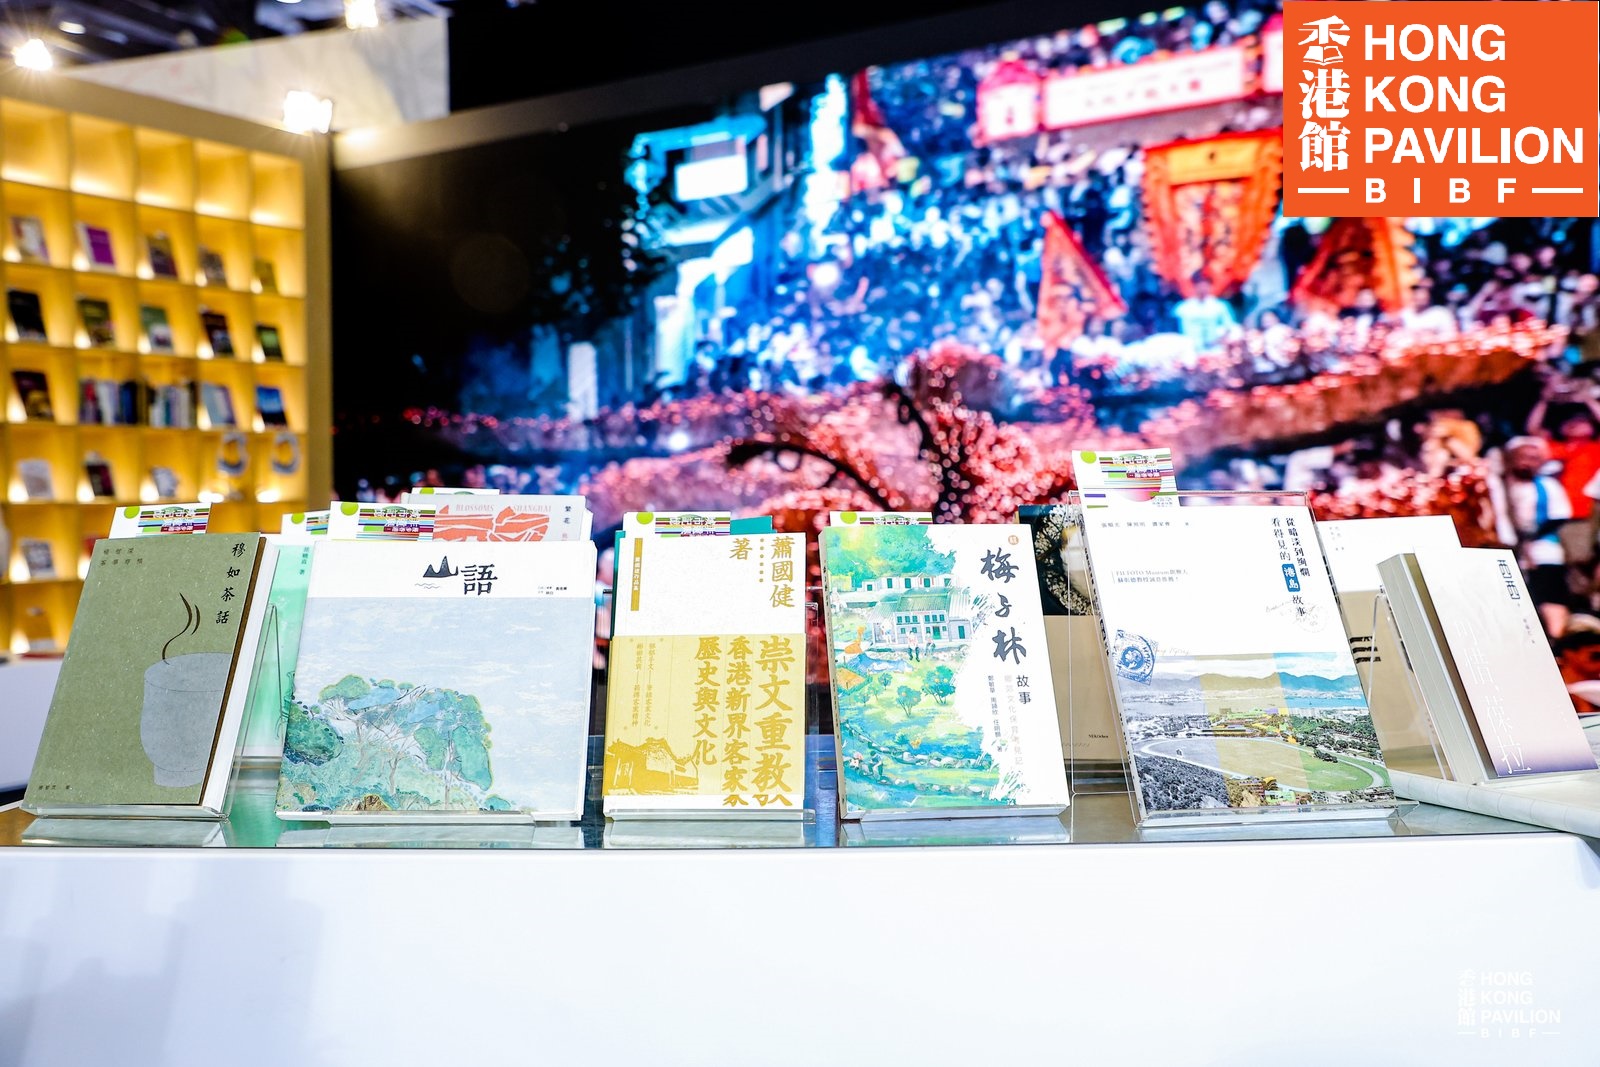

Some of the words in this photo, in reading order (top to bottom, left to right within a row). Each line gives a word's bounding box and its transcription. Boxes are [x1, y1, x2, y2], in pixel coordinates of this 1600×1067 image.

[455, 504, 495, 512] BLOSSOMS
[216, 542, 246, 624] 穆如茶話
[729, 538, 752, 561] 著
[769, 536, 796, 608] 蕭國健
[692, 636, 722, 766] 歷史與文化
[721, 635, 753, 793] 香港新界客家
[751, 635, 795, 793] 崇文重教
[1016, 675, 1031, 704] 故事
